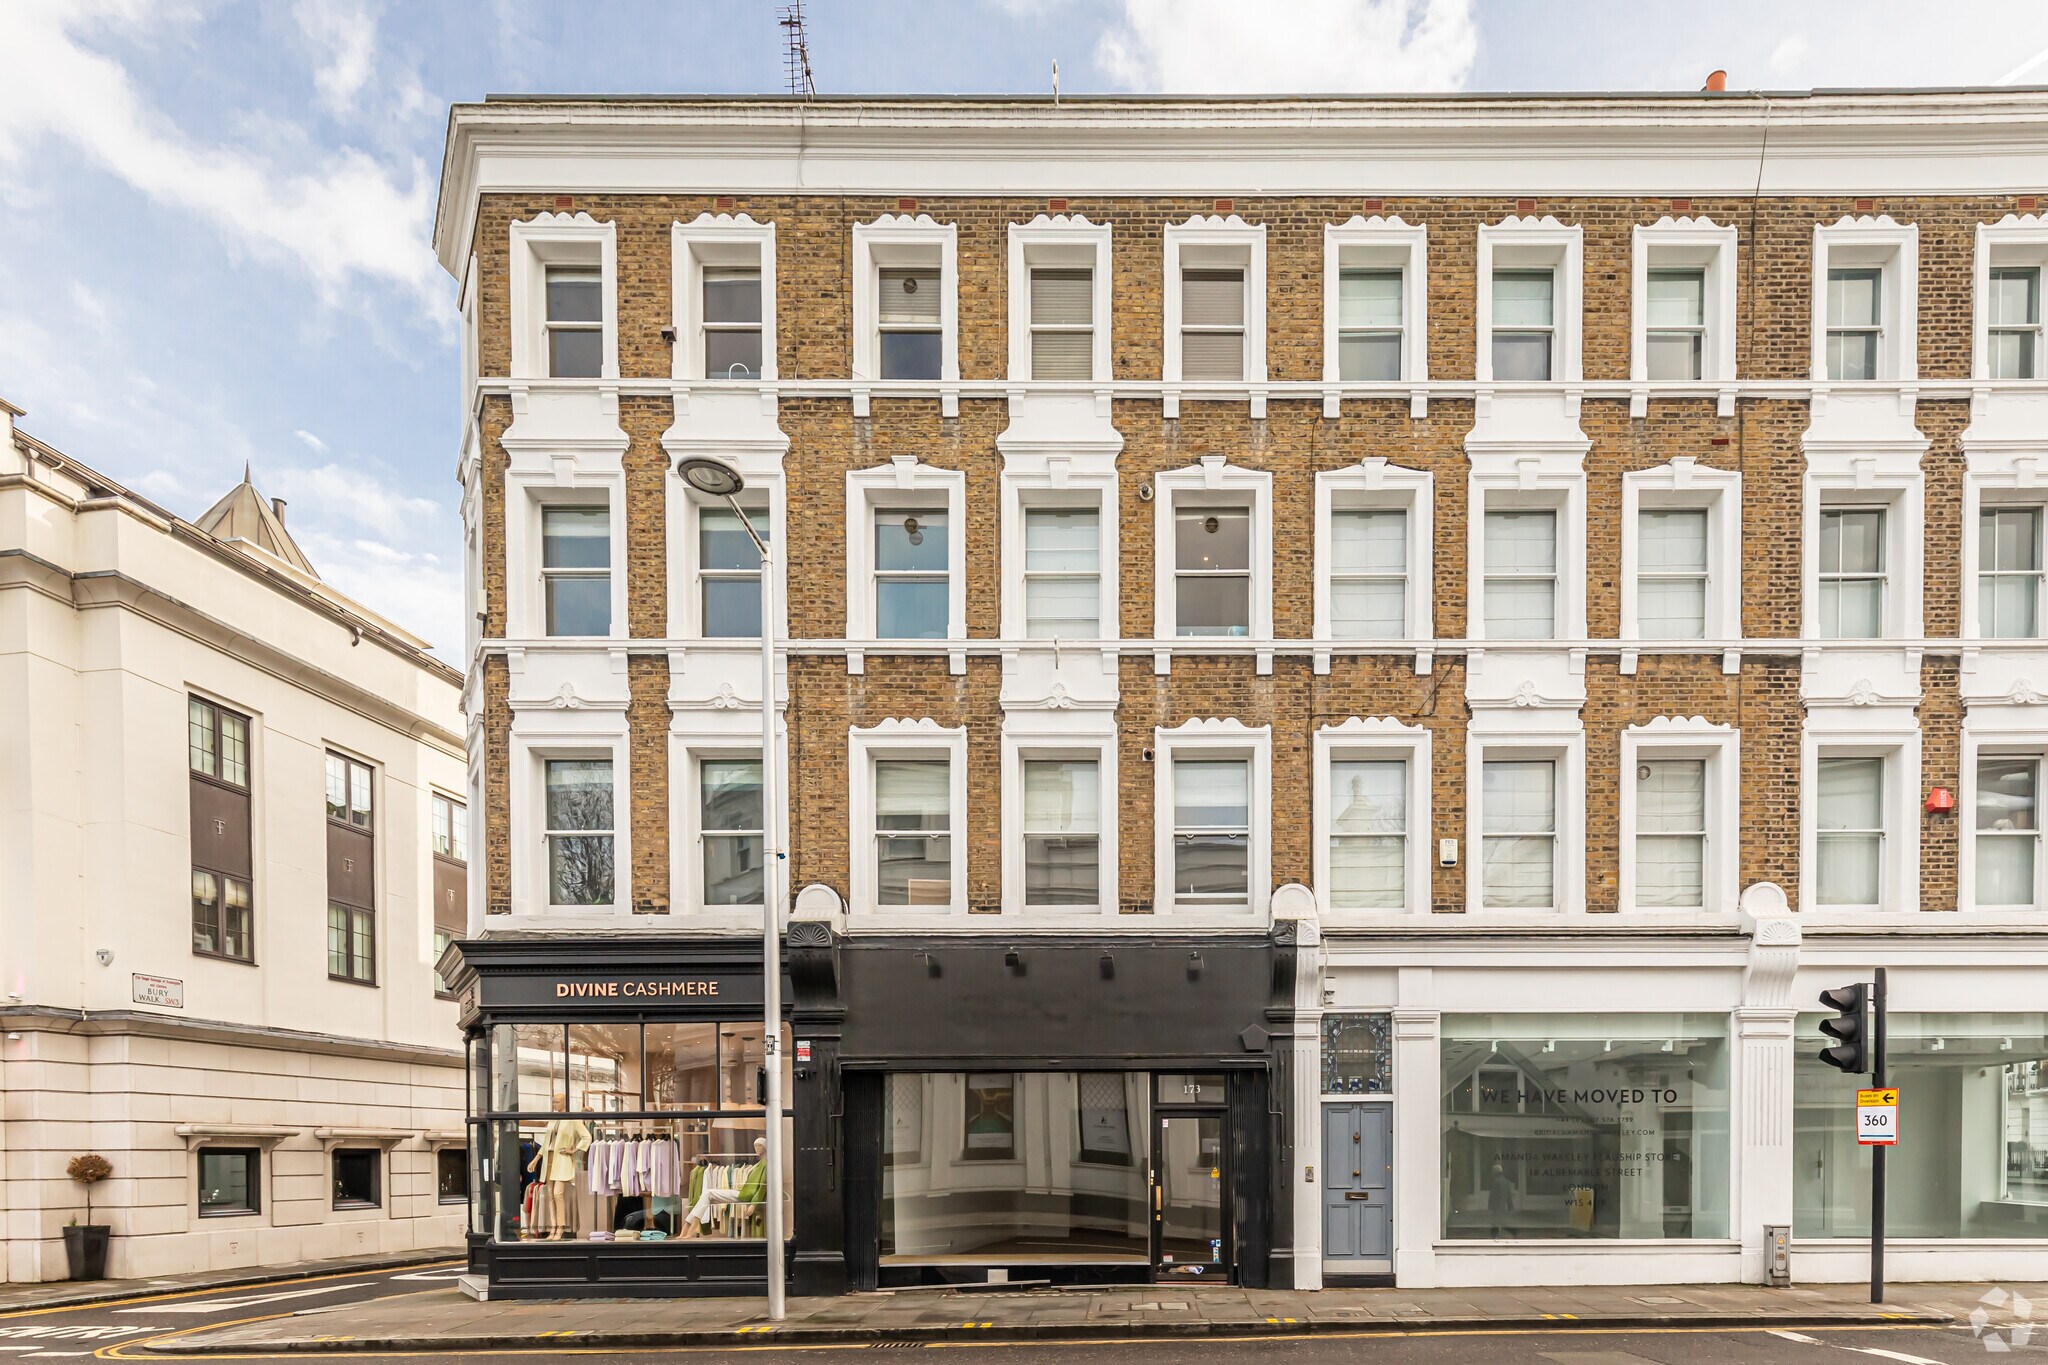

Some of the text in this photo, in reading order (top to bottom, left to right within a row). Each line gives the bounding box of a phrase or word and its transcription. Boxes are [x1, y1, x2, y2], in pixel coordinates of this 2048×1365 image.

[147, 988, 169, 997] BURY
[556, 981, 719, 997] DIVINE CASHMERE
[138, 993, 160, 1003] WALK
[1183, 1085, 1201, 1094] 173
[1482, 1089, 1678, 1104] WE HAVE MOVED TO
[1864, 1115, 1888, 1126] 360
[1493, 1152, 1539, 1162] AMANDA
[1606, 1168, 1643, 1177] STREET
